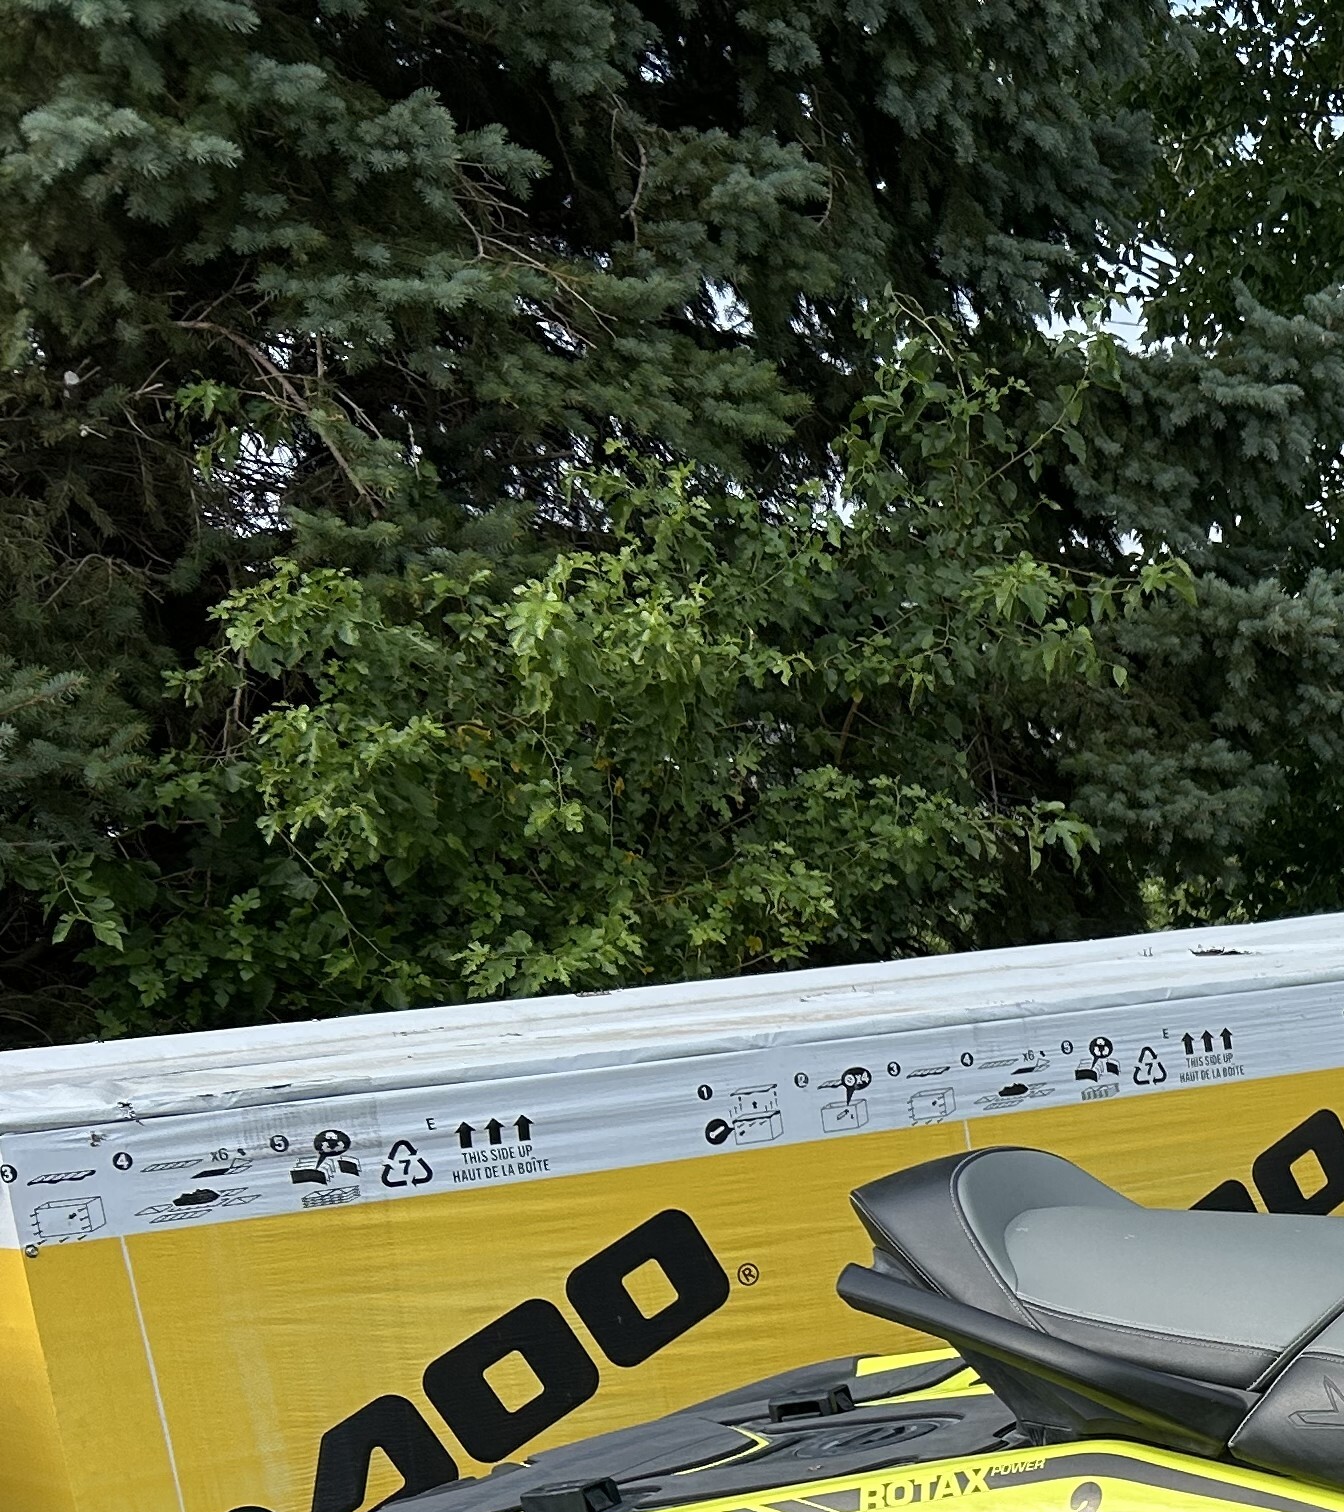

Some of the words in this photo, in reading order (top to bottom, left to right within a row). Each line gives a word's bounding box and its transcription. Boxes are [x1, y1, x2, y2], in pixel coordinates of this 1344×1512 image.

[425, 1117, 438, 1131] E
[461, 1150, 489, 1165] THIS
[490, 1147, 516, 1162] SIDE
[517, 1144, 533, 1159] UP
[452, 1168, 483, 1183] HAUT
[484, 1165, 500, 1180] DE
[502, 1163, 516, 1177] LA
[859, 1467, 993, 1512] ROTAX
[990, 1459, 1047, 1477] POWER
